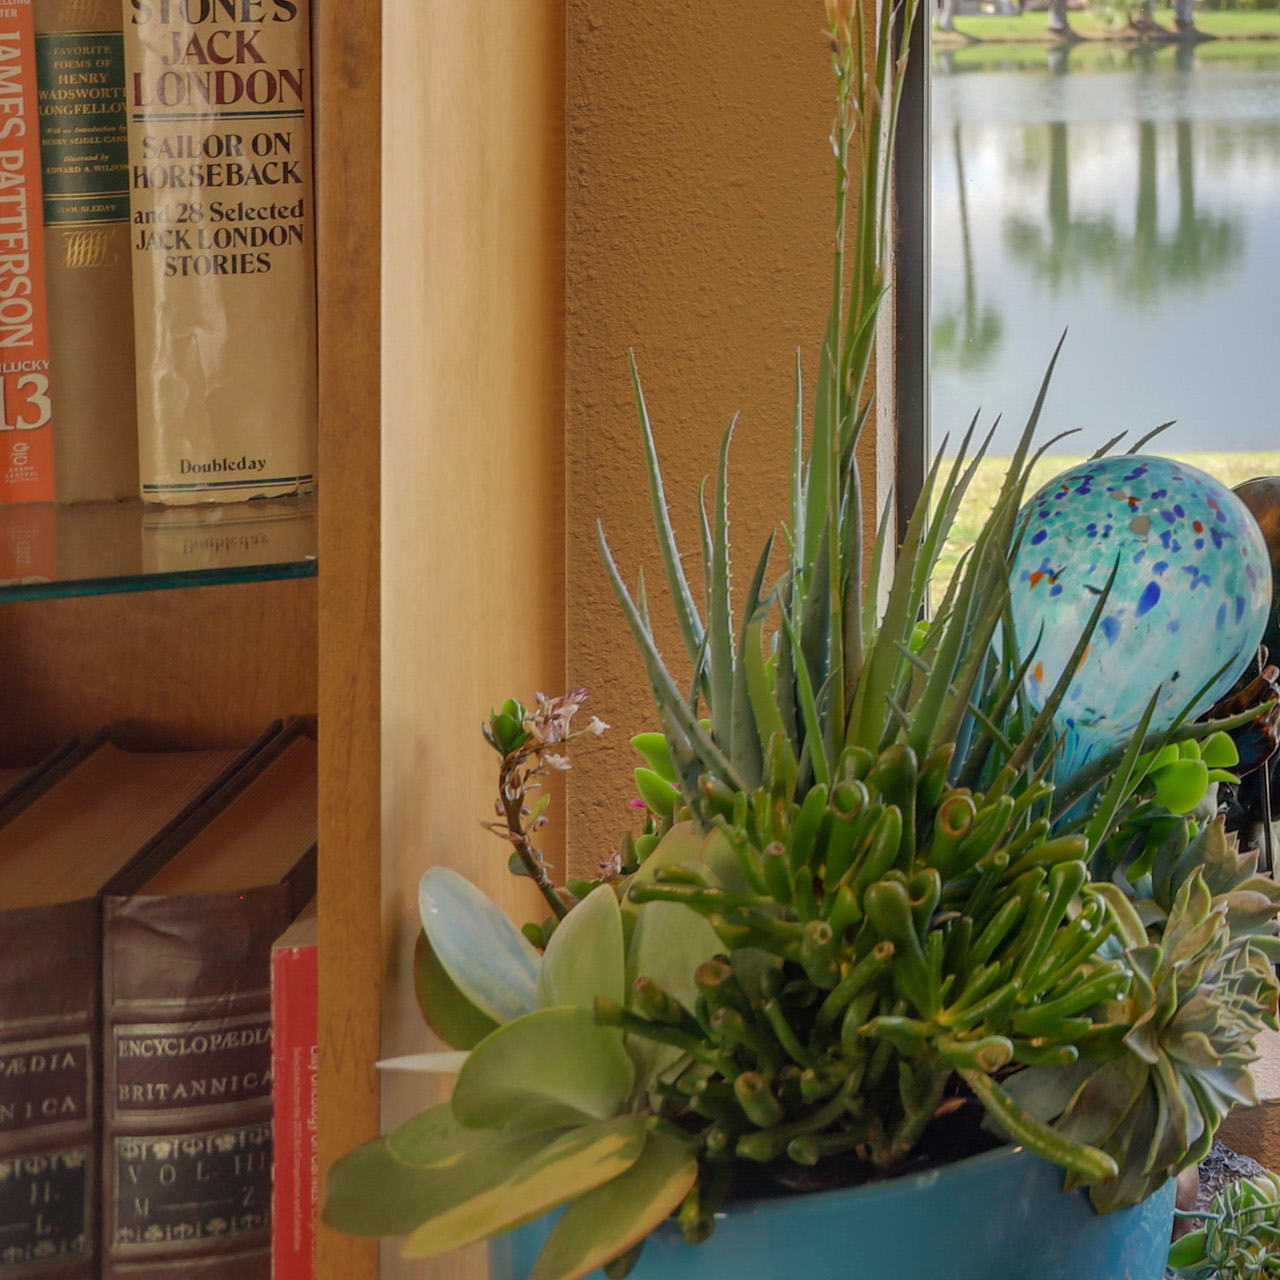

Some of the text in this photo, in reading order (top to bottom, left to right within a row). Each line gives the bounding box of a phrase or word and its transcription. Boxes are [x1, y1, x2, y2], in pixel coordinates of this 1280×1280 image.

[54, 45, 111, 55] FAVORITE
[162, 30, 266, 65] JACK
[54, 59, 112, 69] POEMS OF
[58, 73, 108, 85] HENRY
[133, 68, 304, 107] LONDON
[142, 132, 292, 159] SAILOR ON
[133, 161, 304, 188] HORSEBACK
[134, 199, 304, 224] and 28 Selected
[0, 149, 34, 347] PATTERSON
[136, 224, 304, 250] JACK LONDON
[164, 253, 271, 277] STORIES
[180, 456, 266, 474] Doubleday
[119, 1071, 273, 1101] BRITANNICA
